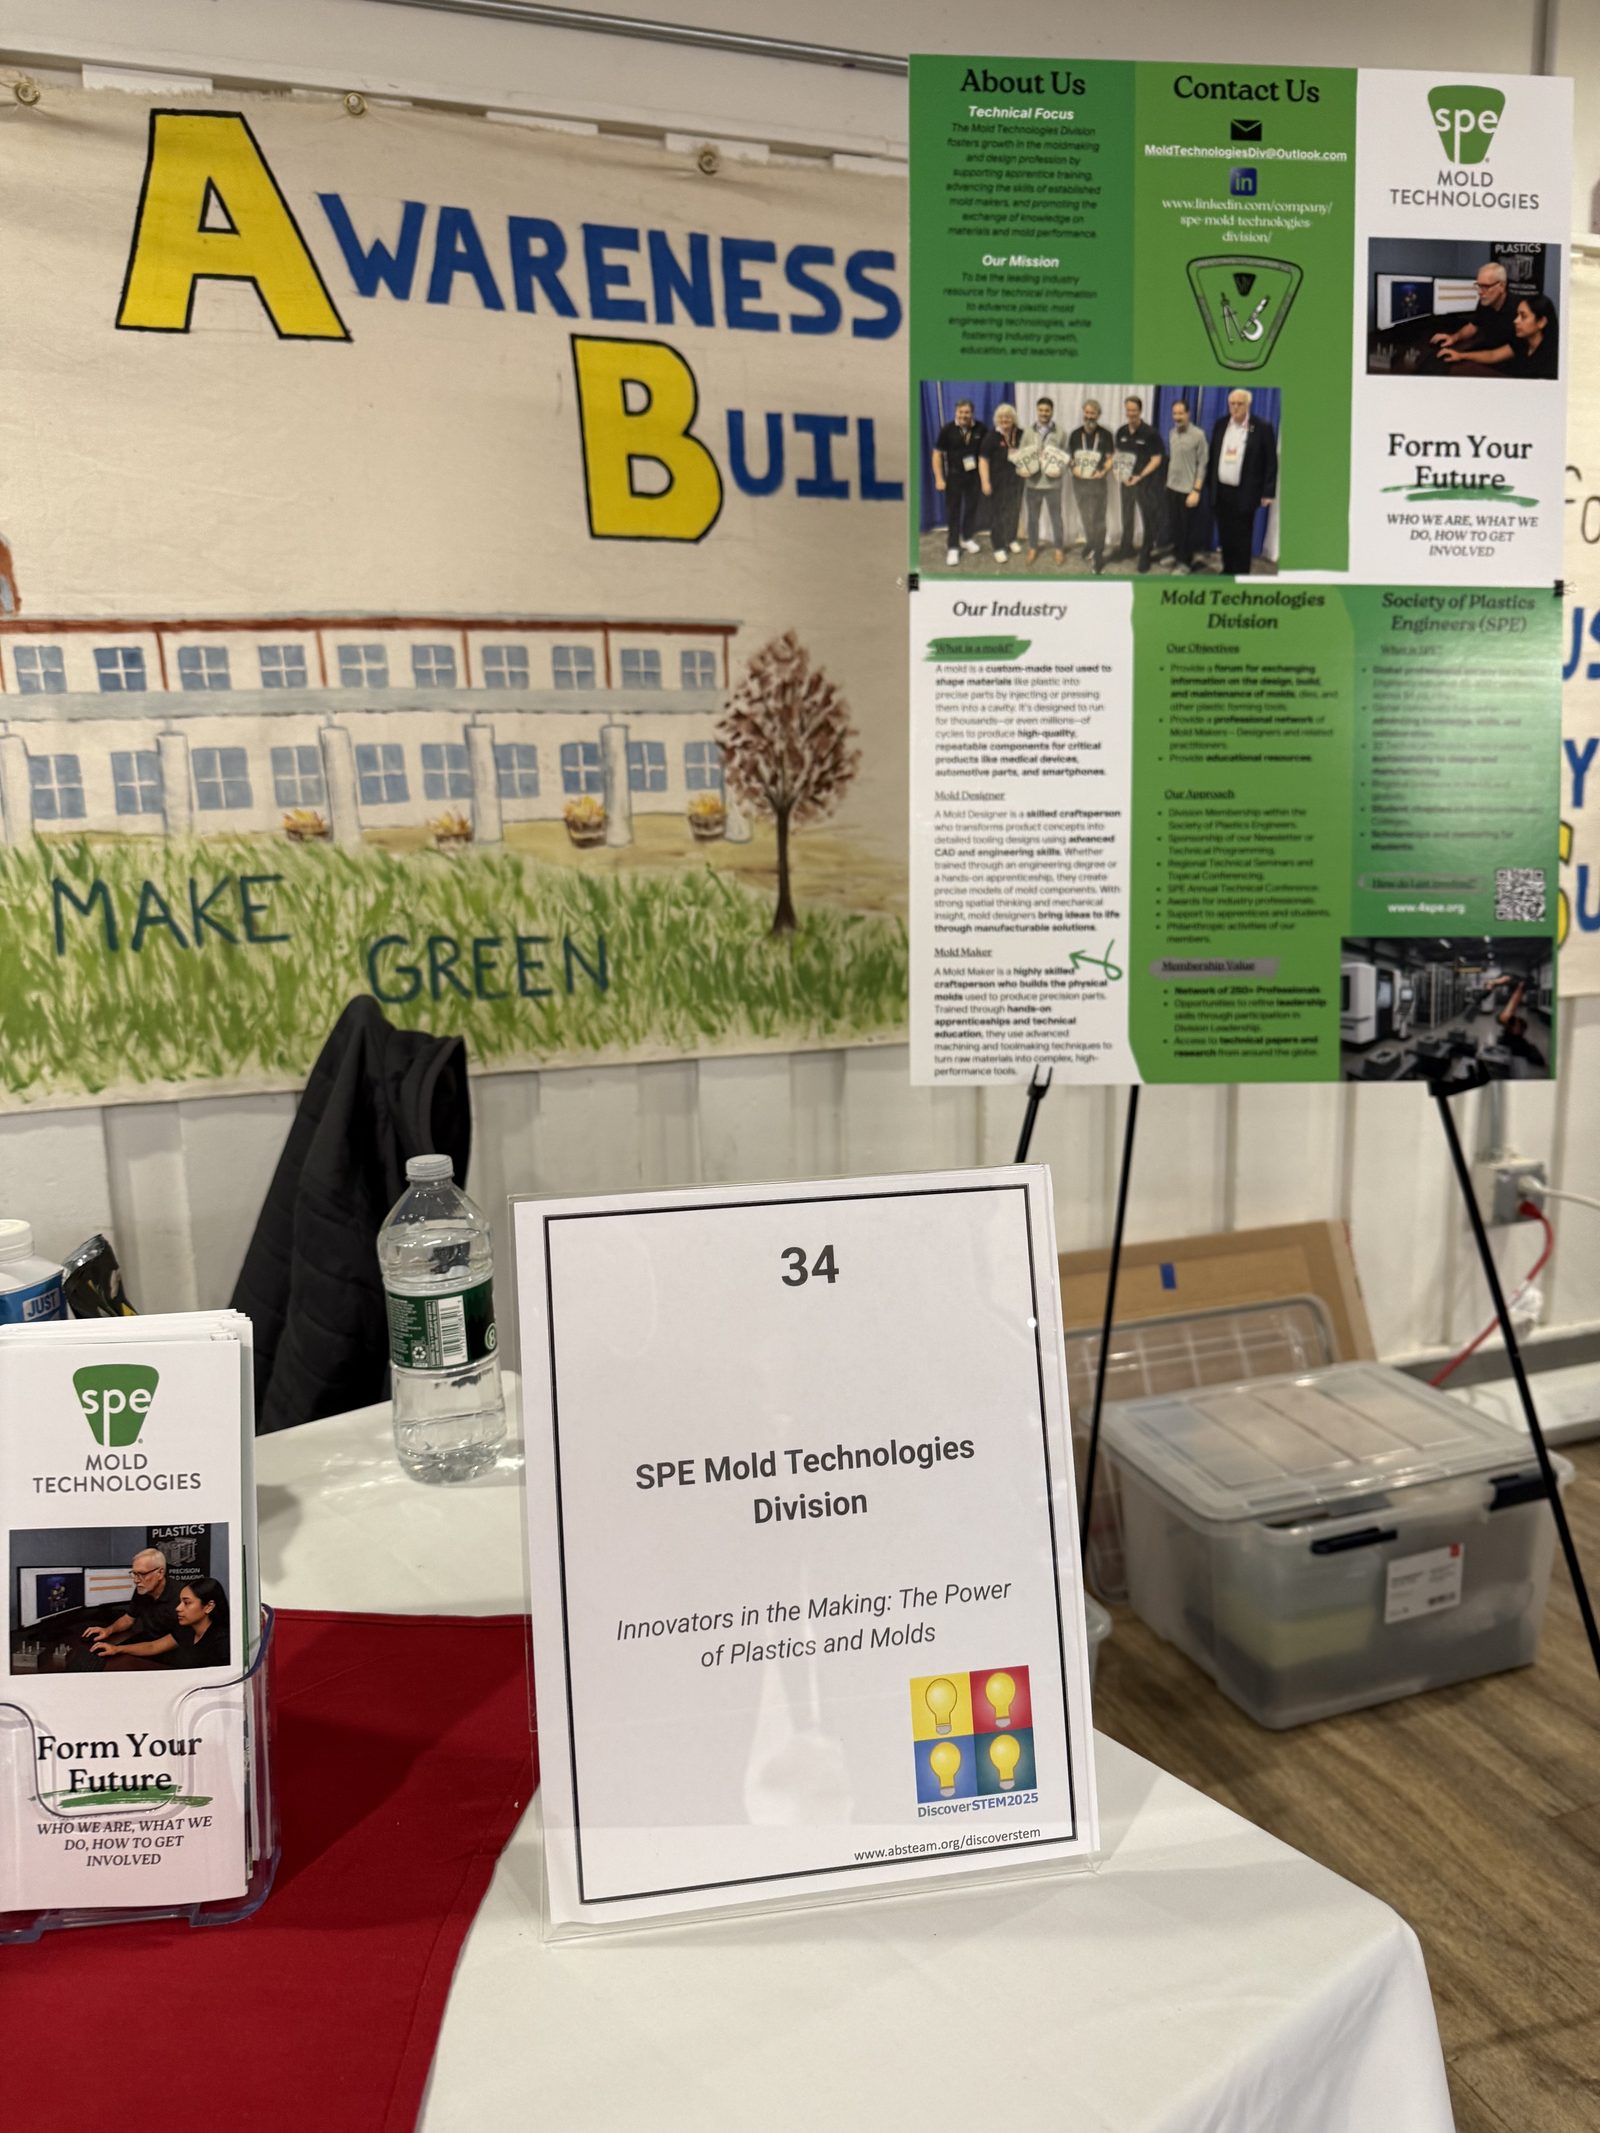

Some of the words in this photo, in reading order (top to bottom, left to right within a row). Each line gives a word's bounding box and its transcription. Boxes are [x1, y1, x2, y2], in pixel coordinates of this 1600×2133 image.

[961, 68, 1044, 94] About
[1051, 71, 1085, 95] Us
[1173, 75, 1279, 101] Contact
[1286, 79, 1319, 102] Us
[969, 105, 1032, 118] Technical
[1034, 107, 1073, 119] Focus
[1434, 104, 1499, 164] spe
[1145, 144, 1347, 162] MoldTechnologiesDiv@Outlook.com
[1437, 170, 1494, 188] MOLD
[1162, 198, 1332, 215] www.linkedin.com/company/
[1390, 188, 1540, 211] TECHNOLOGIES
[114, 106, 904, 343] AWARENESS
[1222, 231, 1272, 243] division/
[1495, 243, 1542, 254] PLASTICS
[982, 254, 1006, 266] Our
[1009, 255, 1059, 267] Mission
[1388, 433, 1460, 457] Form
[1468, 435, 1532, 458] Your
[1416, 466, 1506, 490] Future
[1387, 514, 1419, 524] WHO
[1422, 514, 1442, 525] WE
[1444, 515, 1472, 526] ARE,
[1476, 515, 1515, 526] WHAT
[1518, 516, 1538, 526] WE
[1410, 529, 1431, 541] DO,
[1434, 530, 1467, 540] HOW
[1470, 530, 1487, 541] TO
[1488, 531, 1514, 541] GET
[1429, 545, 1495, 557] INVOLVED
[1161, 589, 1206, 605] Mold
[1210, 590, 1324, 609] Technologies
[1382, 592, 1445, 612] Society
[1448, 593, 1468, 610] of
[1468, 593, 1535, 609] Plastics
[952, 601, 987, 616] Our
[991, 601, 1066, 619] Industry
[1207, 613, 1279, 630] Division
[1391, 614, 1476, 634] Engineers
[1478, 615, 1527, 632] (SPE)
[985, 664, 1052, 672] custom-made
[1054, 664, 1073, 672] tool
[1075, 664, 1099, 672] used
[936, 678, 964, 686] shape
[1031, 678, 1059, 686] plastic
[935, 743, 987, 751] repeatable
[989, 742, 1049, 751] components
[1051, 741, 1065, 750] for
[992, 768, 1018, 777] parts,
[1042, 768, 1105, 776] smartphones.
[934, 791, 960, 800] Mold
[960, 790, 1004, 801] Designer
[968, 810, 1006, 818] Designer
[1059, 809, 1120, 818] craftsperson
[51, 873, 295, 954] MAKE
[934, 924, 972, 934] through
[974, 924, 1050, 932] manufacturable
[1052, 923, 1096, 931] solutions.
[934, 948, 960, 957] Mold
[960, 947, 992, 957] Maker
[366, 932, 611, 1005] GREEN
[1162, 962, 1226, 971] Membership
[1226, 961, 1254, 970] Value
[934, 1017, 1010, 1026] apprenticeships
[780, 1244, 839, 1288] 34
[27, 1292, 56, 1317] JUST
[81, 1387, 152, 1447] spe
[85, 1454, 148, 1471] MOLD
[636, 1459, 694, 1489] SPE
[704, 1451, 776, 1482] Mold
[784, 1437, 974, 1474] Technologies
[32, 1473, 202, 1494] TECHNOLOGIES
[753, 1492, 868, 1526] Division
[152, 1524, 205, 1538] PLASTICS
[617, 1612, 732, 1640] Innovators
[741, 1606, 758, 1626] in
[767, 1601, 800, 1622] the
[808, 1593, 890, 1618] Making:
[900, 1587, 937, 1608] The
[945, 1583, 1010, 1604] Power
[701, 1644, 724, 1666] of
[731, 1637, 815, 1664] Plastics
[824, 1628, 862, 1653] and
[870, 1622, 934, 1648] Molds
[35, 1736, 118, 1763] Form
[127, 1733, 201, 1757] Your
[68, 1768, 173, 1795] Future
[918, 1793, 1039, 1818] DiscoverSTEM2025
[37, 1819, 74, 1834] WHO
[76, 1821, 101, 1832] WE
[103, 1820, 134, 1832] ARE,
[138, 1816, 184, 1831] WHAT
[188, 1815, 212, 1828] WE
[64, 1839, 88, 1851] DO,
[92, 1838, 129, 1849] HOW
[132, 1837, 151, 1848] TO
[154, 1835, 184, 1847] GET
[854, 1827, 1041, 1861] www.absteam.org/discoverstem
[85, 1853, 162, 1867] INVOLVED
